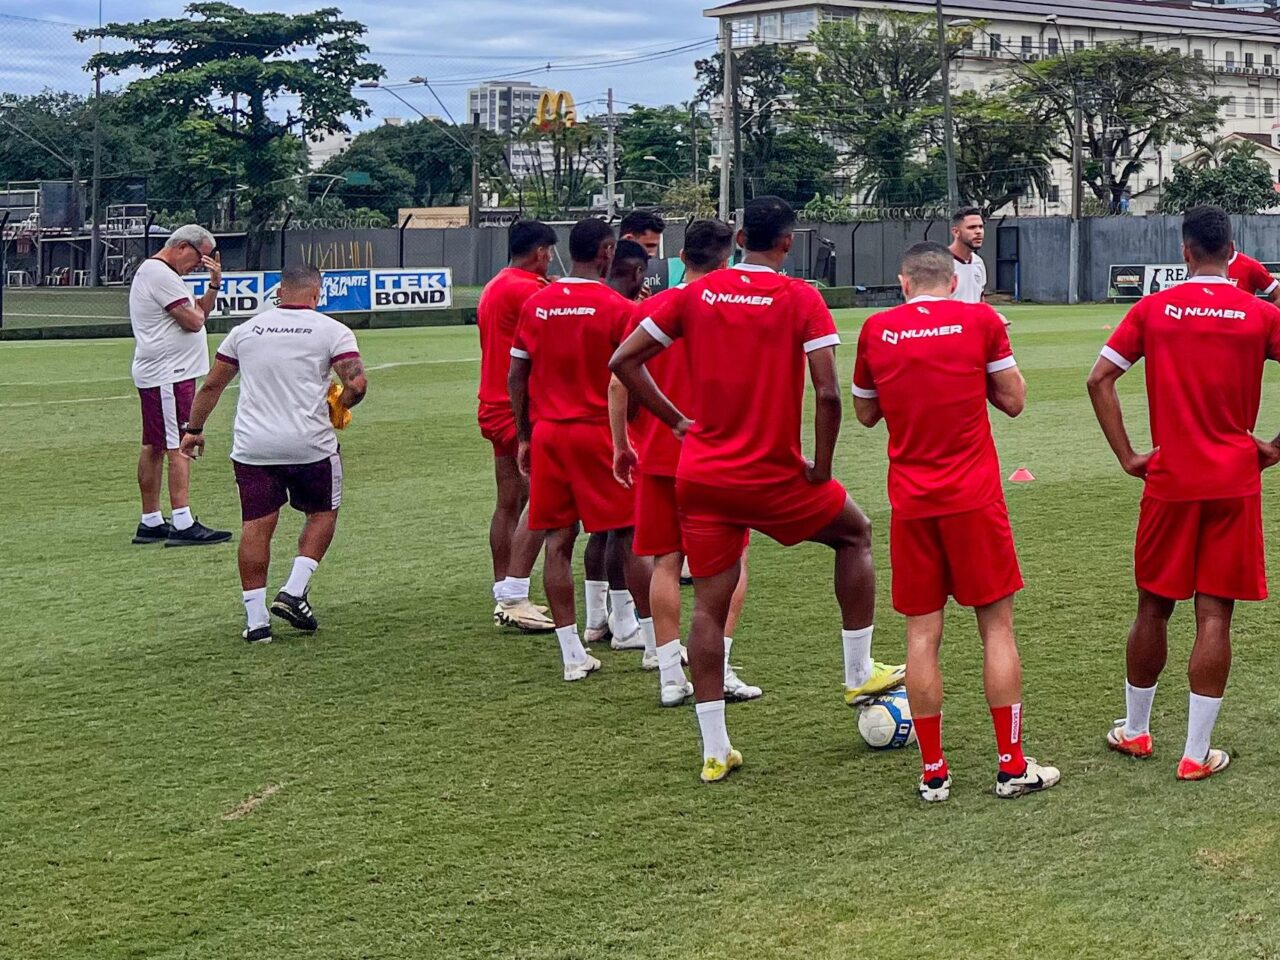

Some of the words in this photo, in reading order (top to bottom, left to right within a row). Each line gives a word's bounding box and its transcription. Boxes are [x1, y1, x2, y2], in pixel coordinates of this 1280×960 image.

[322, 277, 340, 288] FAZ
[340, 276, 369, 287] PARTE
[379, 275, 443, 289] TEK
[644, 273, 661, 288] ank
[213, 296, 258, 311] ND
[375, 290, 445, 305] BOND
[717, 293, 774, 306] NUMER
[549, 306, 596, 316] NUMER
[1185, 306, 1246, 320] NUMER
[900, 324, 963, 340] NUMER
